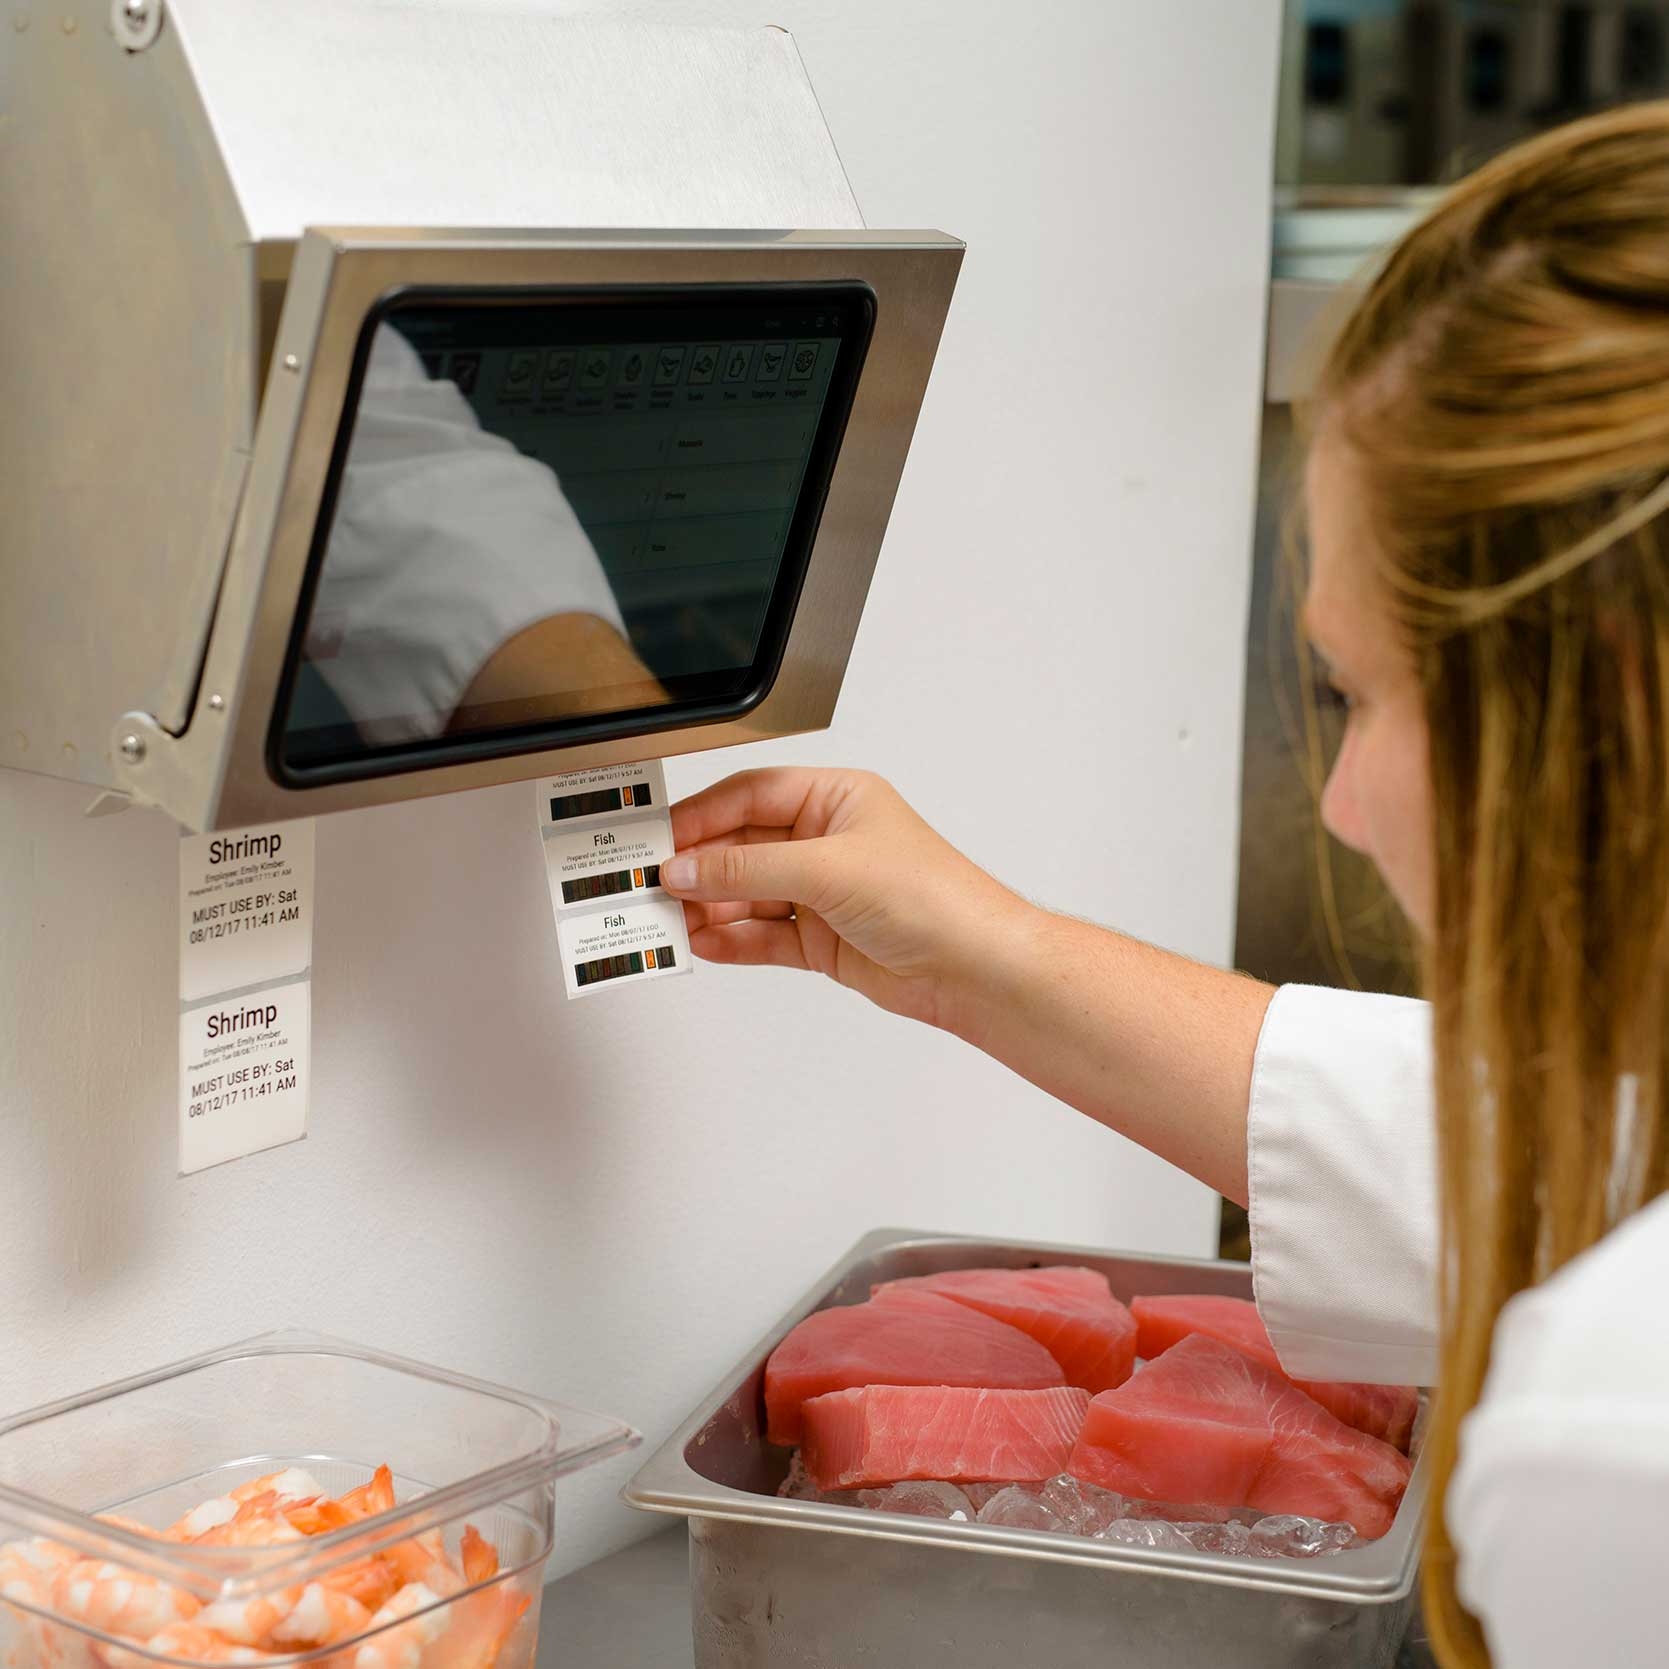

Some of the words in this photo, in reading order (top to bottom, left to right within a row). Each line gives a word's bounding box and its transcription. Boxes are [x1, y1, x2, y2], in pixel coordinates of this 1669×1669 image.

[209, 834, 281, 864] Shrimp
[594, 832, 615, 846] Fish
[193, 902, 228, 925] MUST
[230, 897, 253, 914] USE
[255, 892, 275, 908] BY:
[278, 889, 297, 904] Sat
[604, 914, 625, 928] Fish
[190, 919, 241, 944] 08/12/17
[245, 911, 275, 930] 11:41
[279, 906, 299, 923] AM
[207, 1005, 277, 1038] Shrimp
[192, 1075, 224, 1098] MUST
[227, 1068, 250, 1086] USE
[253, 1063, 272, 1079] BY:
[275, 1058, 294, 1073] Sat
[189, 1091, 238, 1118] 08/12/17
[242, 1082, 272, 1101] 11:41
[276, 1075, 296, 1092] AM
